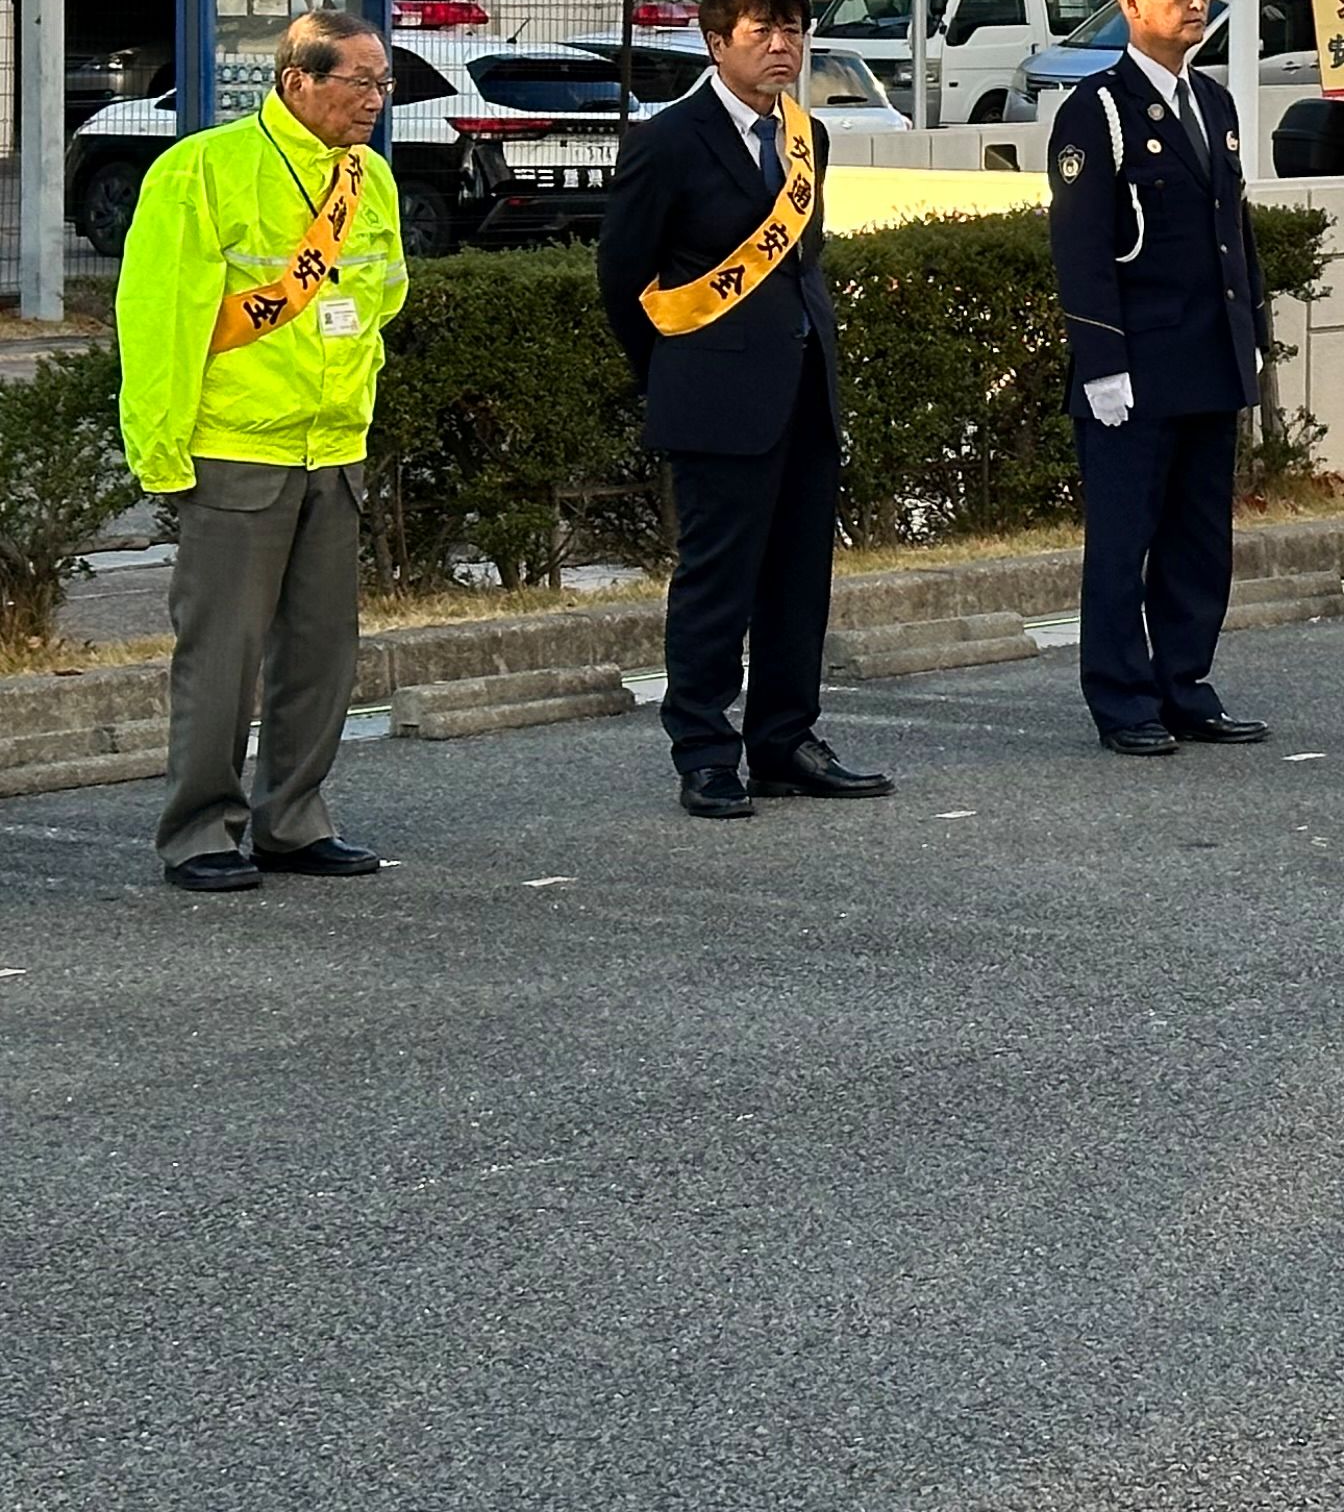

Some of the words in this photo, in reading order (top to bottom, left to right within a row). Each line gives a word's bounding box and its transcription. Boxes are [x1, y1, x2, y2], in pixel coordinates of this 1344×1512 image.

[242, 152, 364, 330] 交通安全
[536, 168, 616, 188] 三重県
[709, 135, 813, 300] 交通安全
